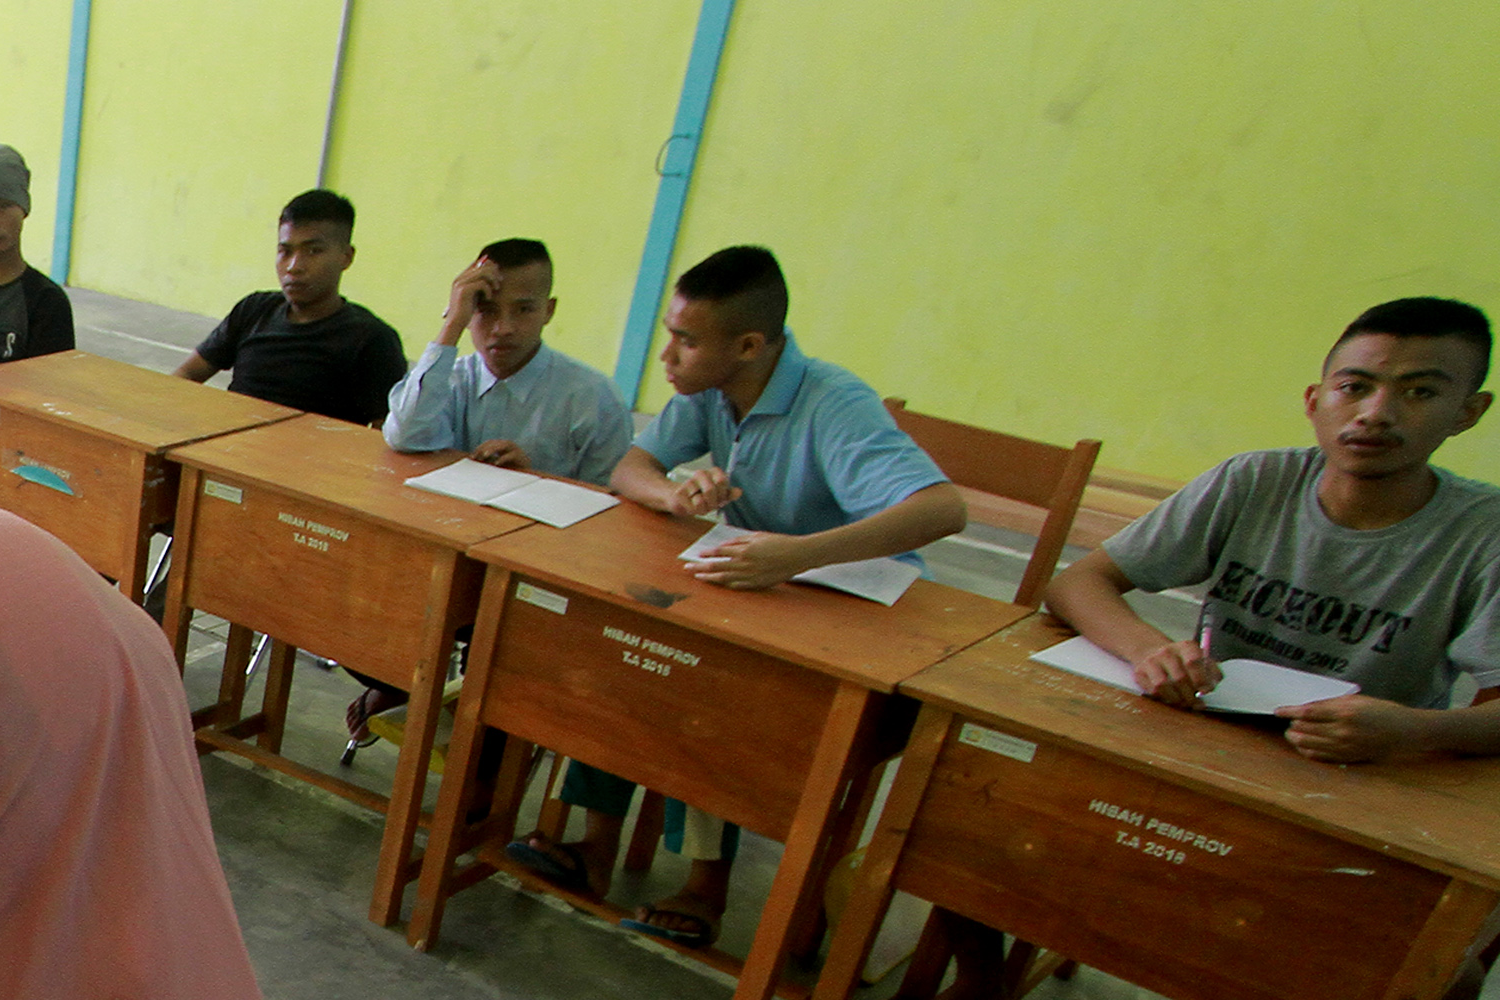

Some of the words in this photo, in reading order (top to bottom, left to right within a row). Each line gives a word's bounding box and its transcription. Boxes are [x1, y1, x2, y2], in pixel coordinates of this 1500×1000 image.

[1208, 561, 1413, 653] KICKOUT
[603, 626, 641, 647] HIBAH
[642, 639, 700, 667] PEMPROV
[1089, 799, 1145, 827] HIBAH
[1146, 818, 1233, 857] PEMPROV
